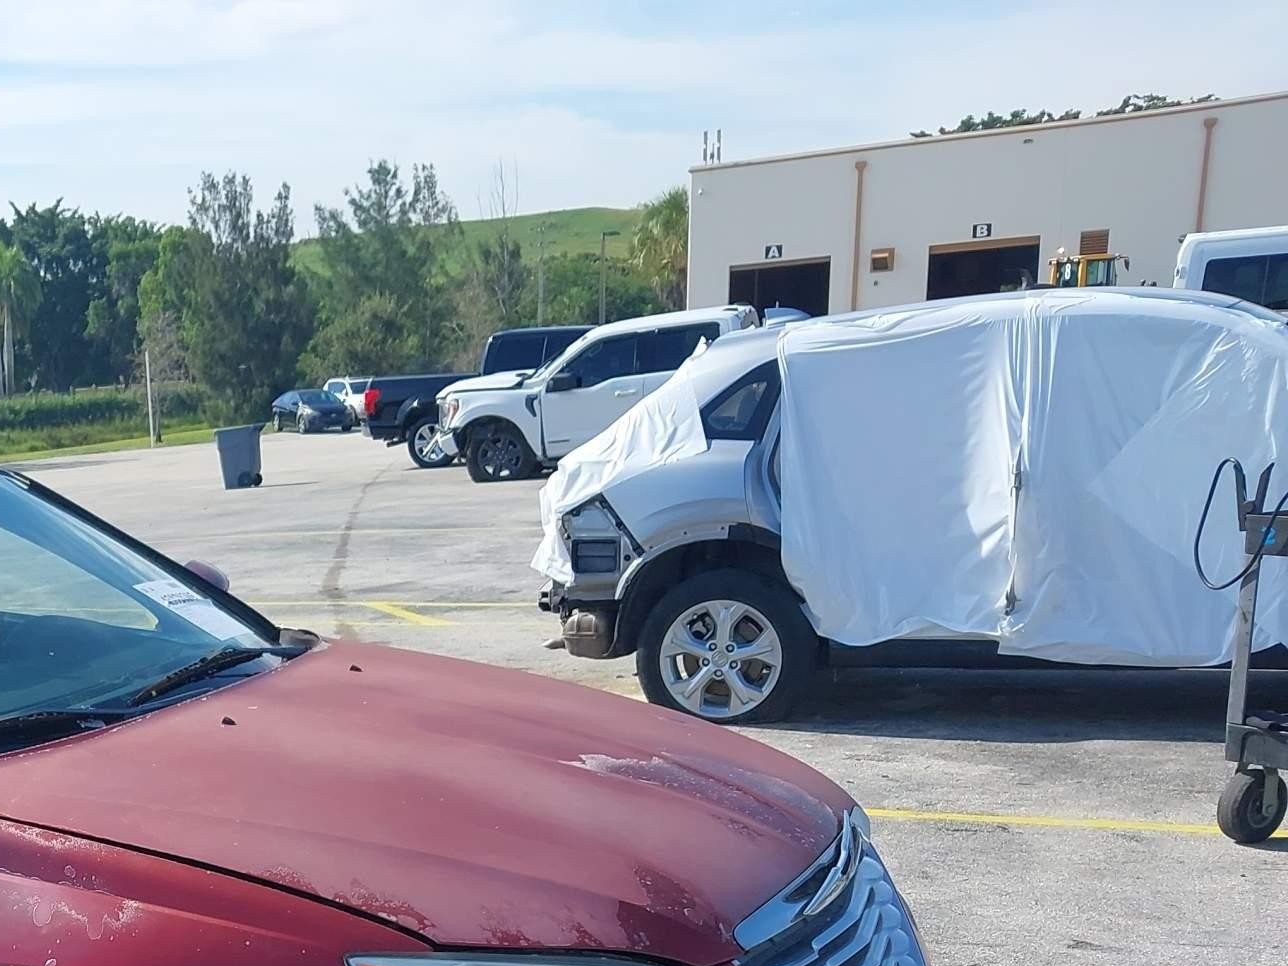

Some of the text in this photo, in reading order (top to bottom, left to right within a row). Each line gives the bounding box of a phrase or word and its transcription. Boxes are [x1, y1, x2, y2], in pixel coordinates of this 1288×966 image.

[975, 224, 989, 238] B
[767, 246, 780, 259] A
[1064, 263, 1072, 280] 8
